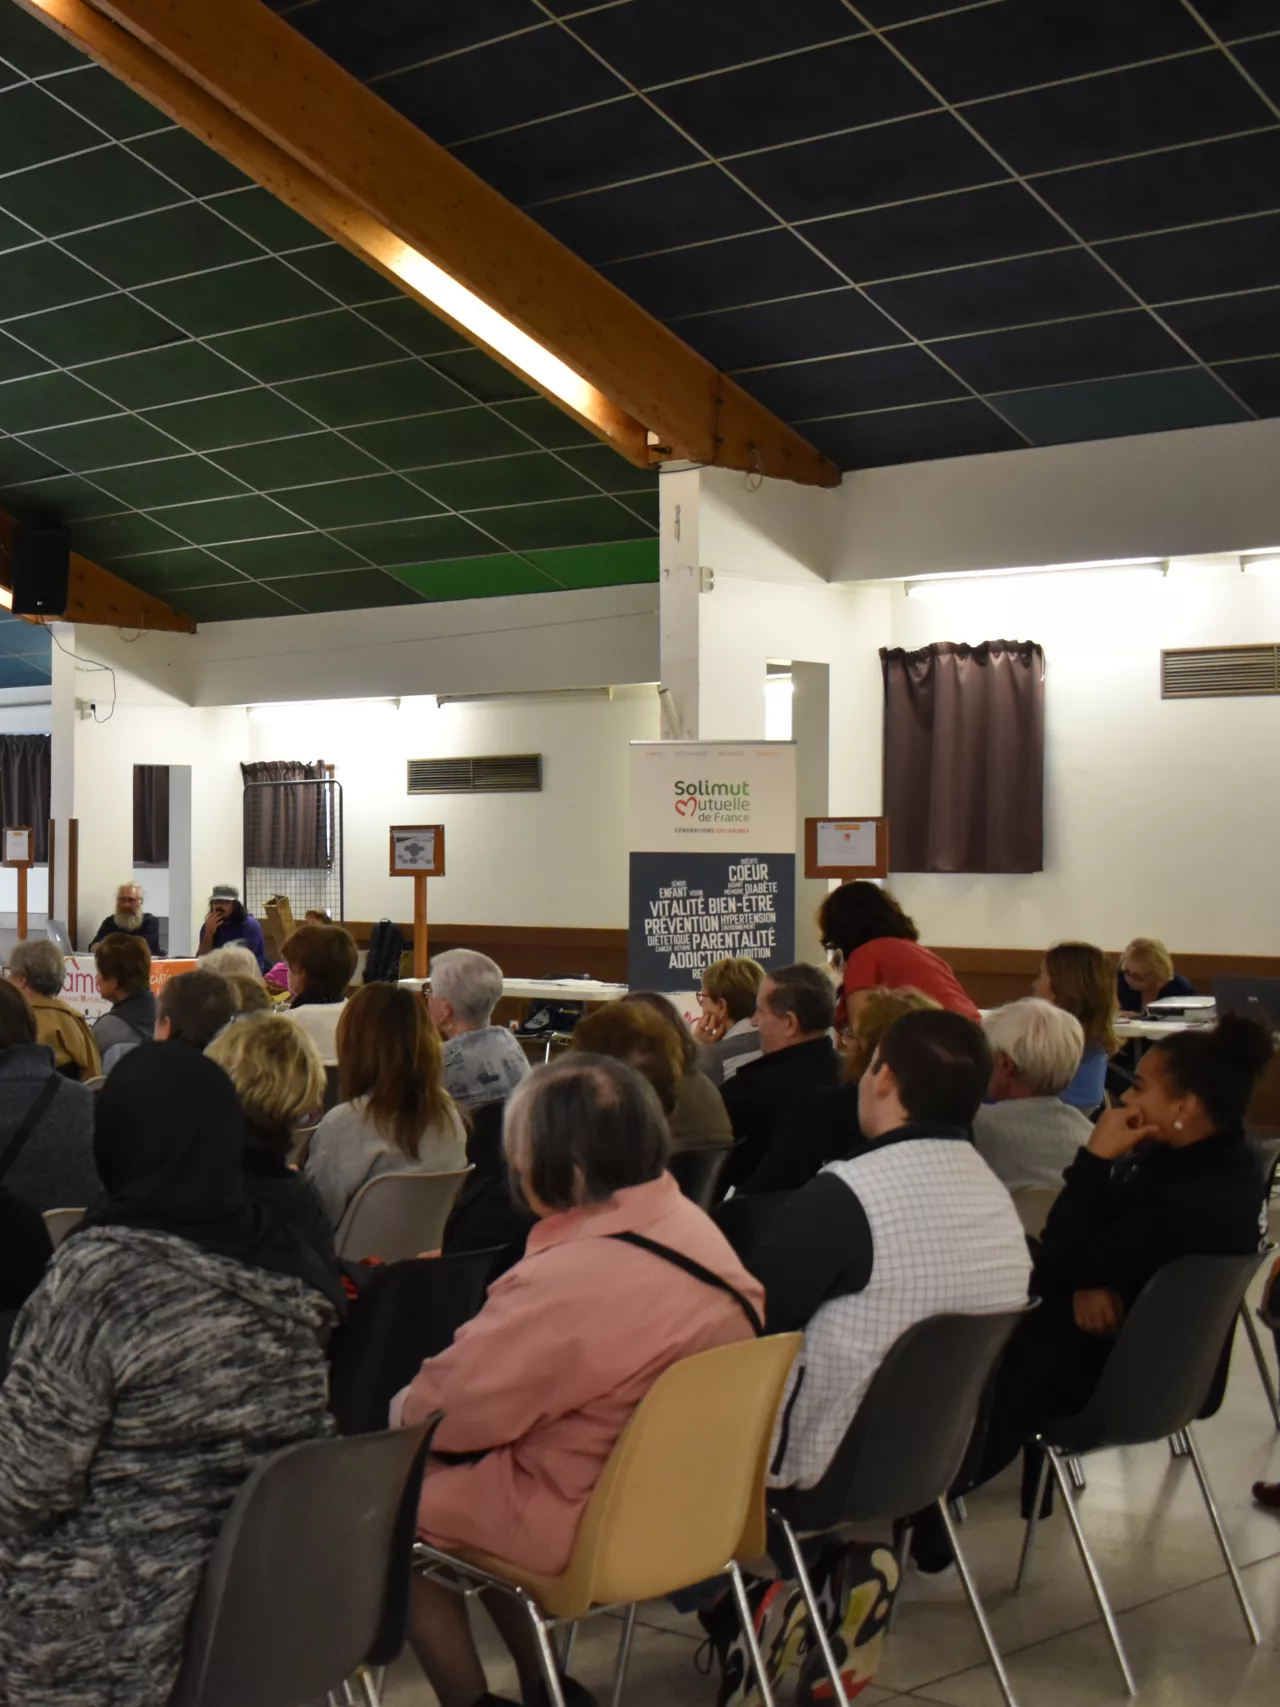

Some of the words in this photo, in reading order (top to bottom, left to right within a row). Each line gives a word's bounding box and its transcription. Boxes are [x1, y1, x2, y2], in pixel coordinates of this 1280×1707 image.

[674, 780, 750, 796] Solimut
[698, 812, 712, 823] de
[714, 812, 751, 823] France
[728, 863, 769, 882] COEUR
[659, 886, 688, 899] ENFANT
[744, 881, 778, 895] DIABÈTE
[649, 896, 706, 917] VITALITÉ
[708, 893, 775, 915] BIEN-ÊTRE
[644, 915, 719, 935] PRÉVENTION
[720, 912, 776, 925] HYPERTENSION
[692, 927, 776, 950] PARENTALITÉ
